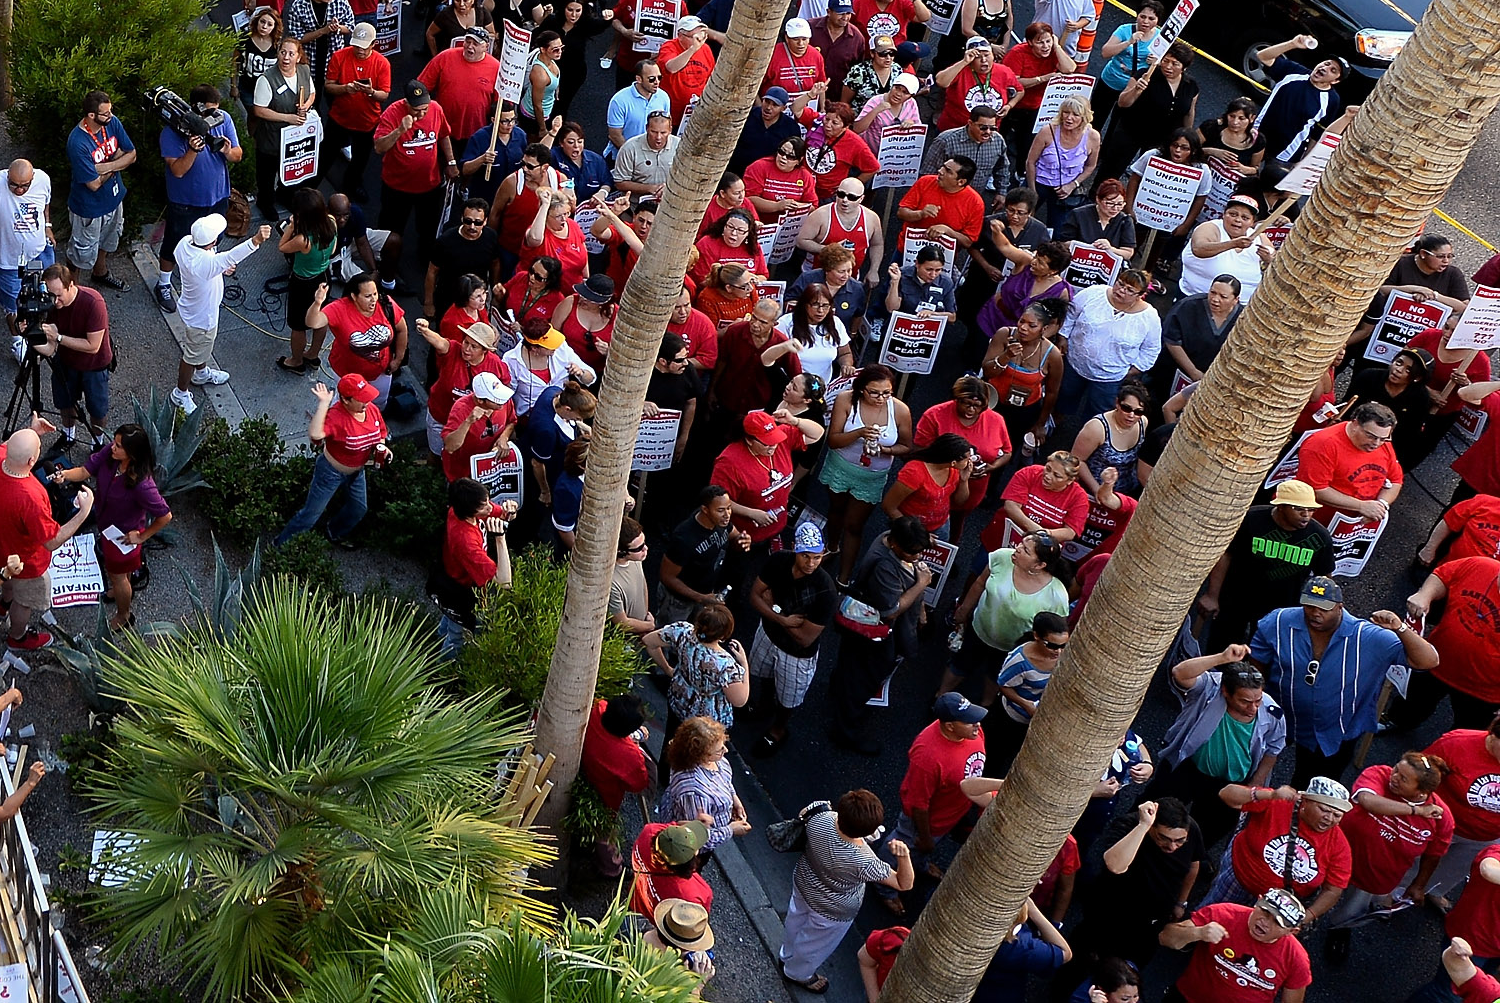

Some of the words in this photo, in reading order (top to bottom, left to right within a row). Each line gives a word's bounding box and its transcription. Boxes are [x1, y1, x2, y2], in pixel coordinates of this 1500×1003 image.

[926, 0, 948, 15] PEACE
[642, 8, 673, 19] JUSTICE
[644, 27, 669, 36] PEACE
[888, 135, 916, 143] UNFAIR
[289, 140, 311, 152] PEACE
[295, 149, 305, 157] NO
[285, 158, 314, 172] JUSTICE
[1150, 160, 1180, 174] DEUTSCHE
[294, 168, 305, 177] NO
[877, 168, 917, 177] WRONG???
[1155, 171, 1190, 186] UNFAIR
[1148, 188, 1161, 197] this
[1175, 195, 1191, 205] right
[1146, 197, 1171, 208] amount
[1136, 202, 1185, 221] WRONG???
[1151, 216, 1163, 224] NO
[1088, 252, 1103, 261] NO
[1073, 257, 1111, 275] JUSTICE
[1082, 271, 1098, 279] NO
[1409, 305, 1426, 315] NO
[1391, 309, 1437, 328] JUSTICE
[895, 327, 936, 337] JUSTICE
[1399, 327, 1416, 337] NO
[895, 346, 926, 355] PEACE
[479, 461, 516, 478] JUSTICE
[491, 477, 503, 487] NO
[490, 483, 512, 495] EACE
[1334, 528, 1376, 538] JUSTICE
[1252, 537, 1314, 566] PUMA
[53, 582, 101, 595] UNFAIR
